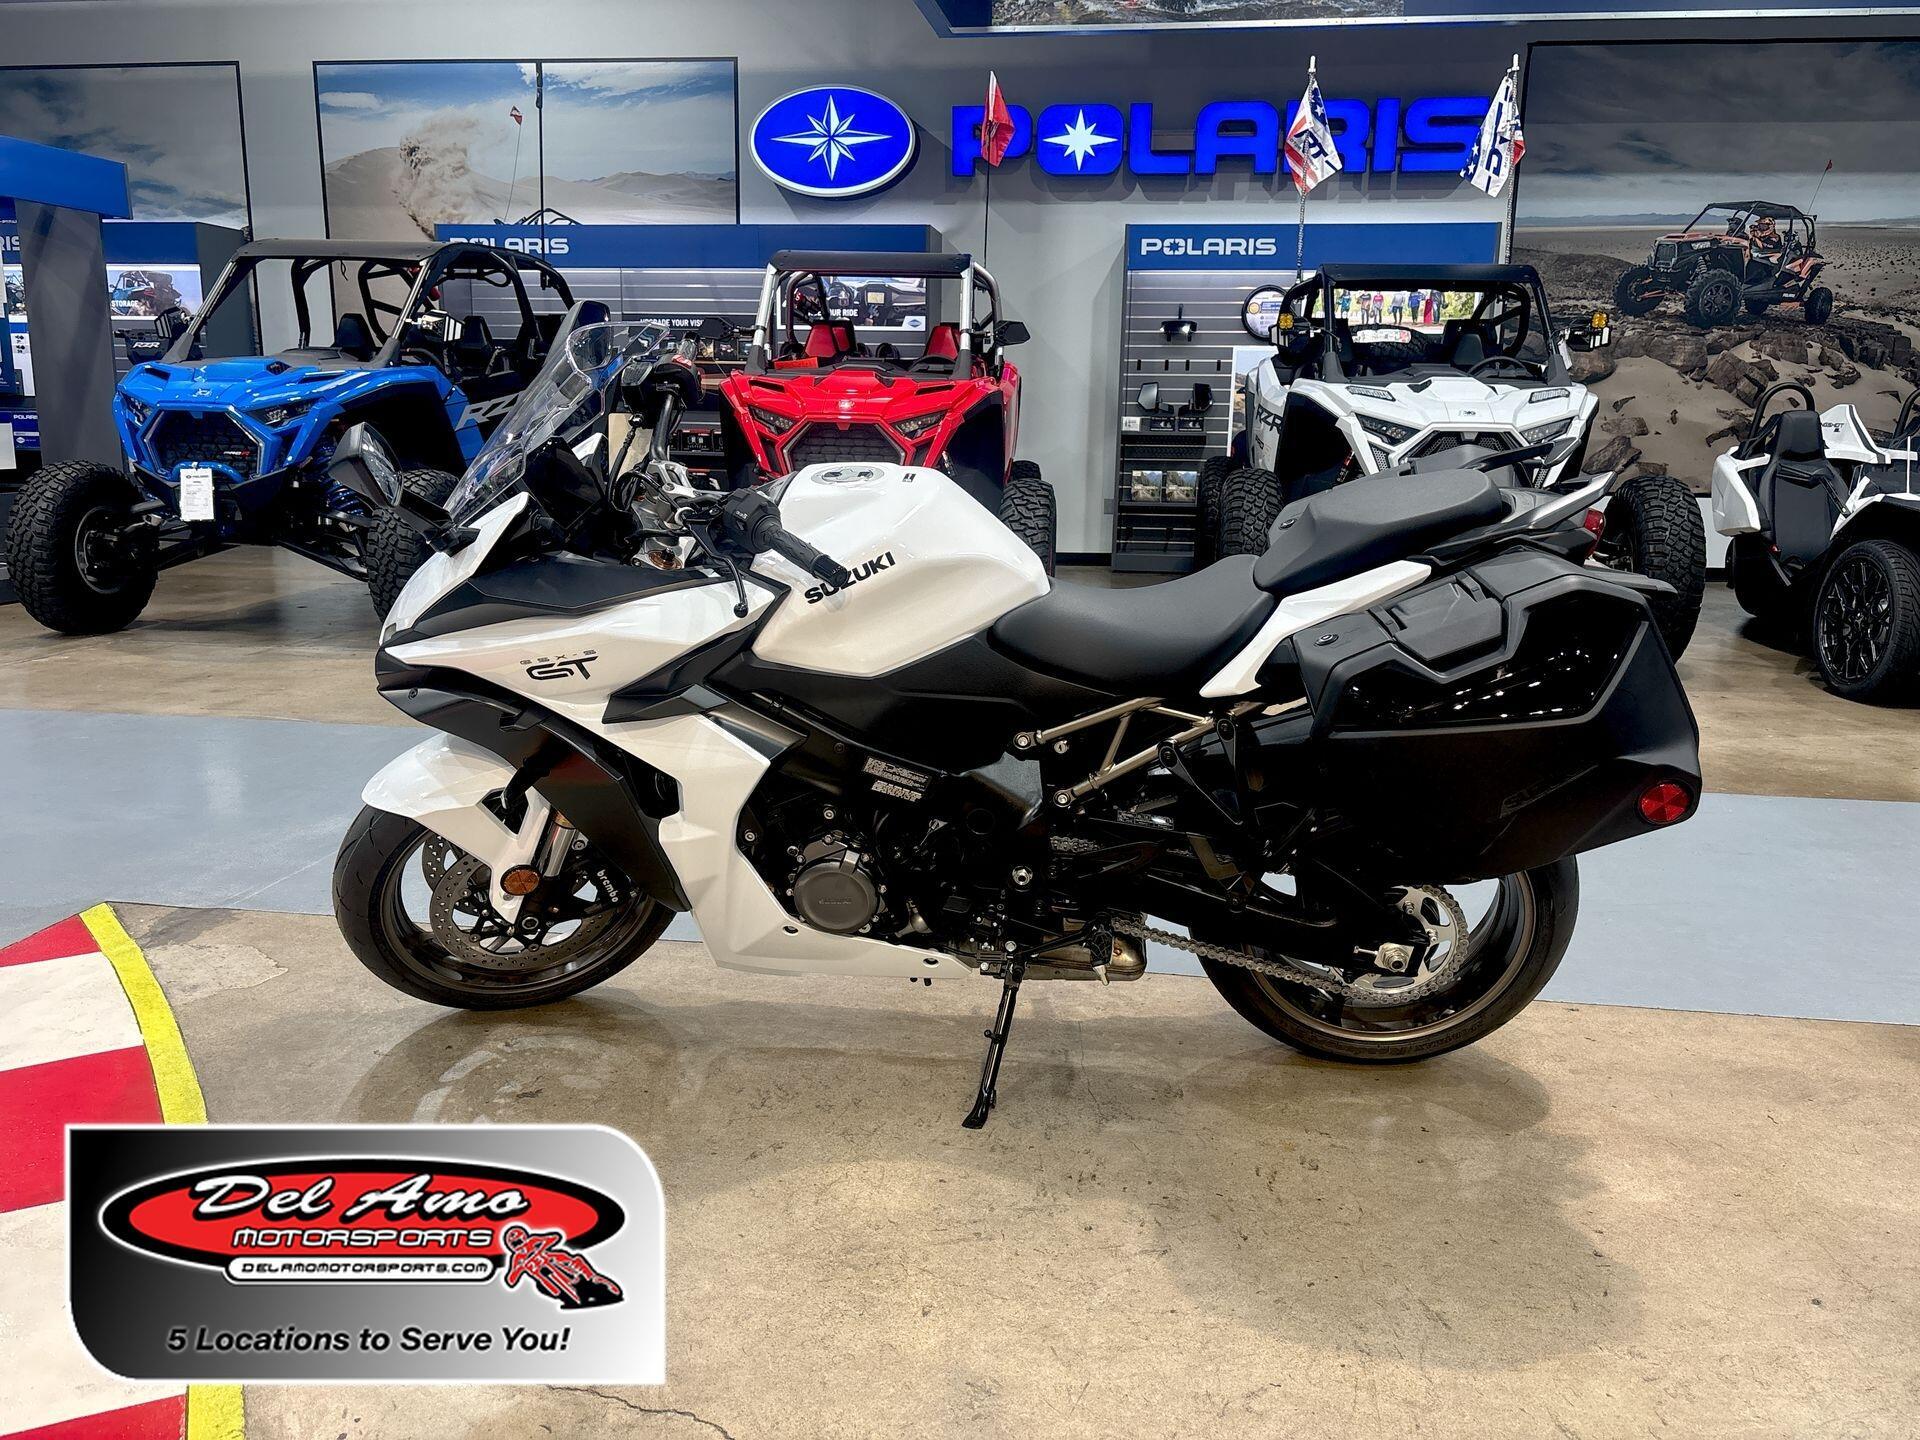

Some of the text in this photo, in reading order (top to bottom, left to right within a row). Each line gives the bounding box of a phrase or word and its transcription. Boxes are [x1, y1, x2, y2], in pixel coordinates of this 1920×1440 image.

[952, 96, 1490, 176] POLARIS
[1141, 238, 1276, 255] POLARIS
[671, 319, 689, 327] YOUR
[842, 309, 859, 317] RIDE
[455, 391, 520, 431] RZ
[1256, 404, 1284, 434] RZR
[526, 656, 599, 680] GT
[597, 869, 619, 903] brembo
